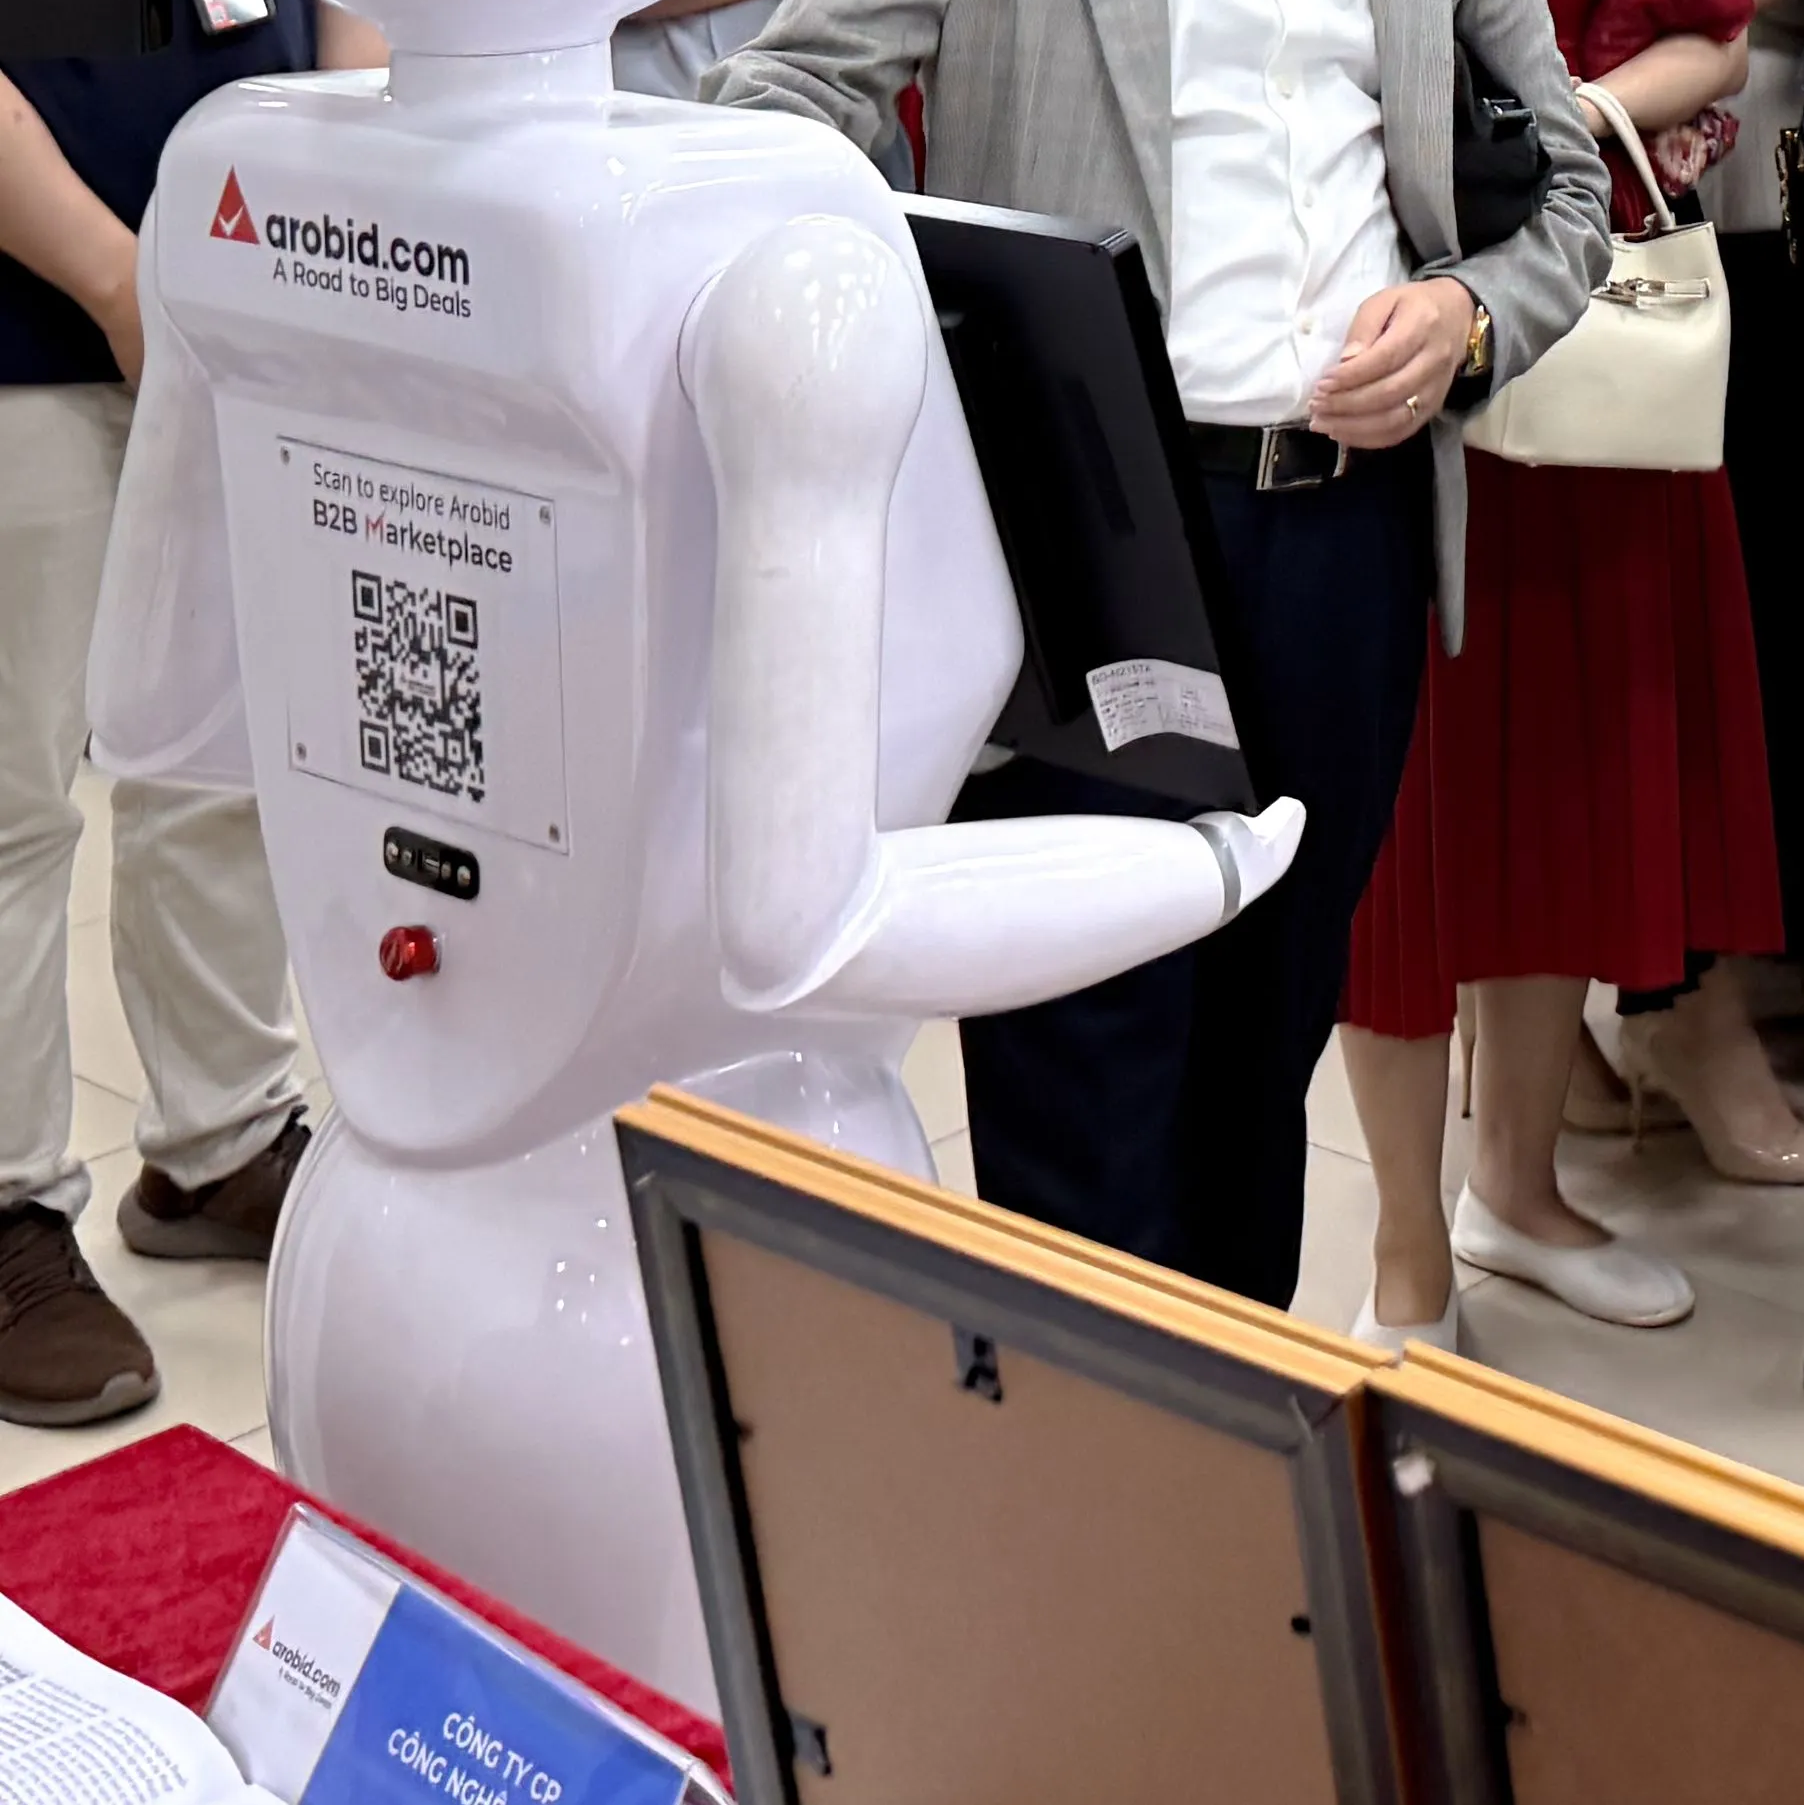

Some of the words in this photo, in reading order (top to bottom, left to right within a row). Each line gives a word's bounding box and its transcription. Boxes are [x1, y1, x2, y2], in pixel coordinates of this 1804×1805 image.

[266, 214, 469, 285] arobid.com
[272, 257, 288, 284] A
[293, 261, 342, 293] Road
[349, 273, 370, 298] to
[375, 277, 408, 312] Big
[414, 283, 472, 318] Deals
[313, 462, 352, 495] Scan
[356, 472, 375, 498] to
[379, 482, 445, 517] explore
[449, 495, 511, 530] Arobid
[313, 498, 358, 534] B2B
[364, 509, 513, 573] Marketplace
[272, 1639, 341, 1698] arobid.com
[387, 1728, 448, 1785] CÔNG
[442, 1712, 504, 1769] CÔNG
[502, 1749, 534, 1787] TY
[529, 1771, 562, 1805] CP
